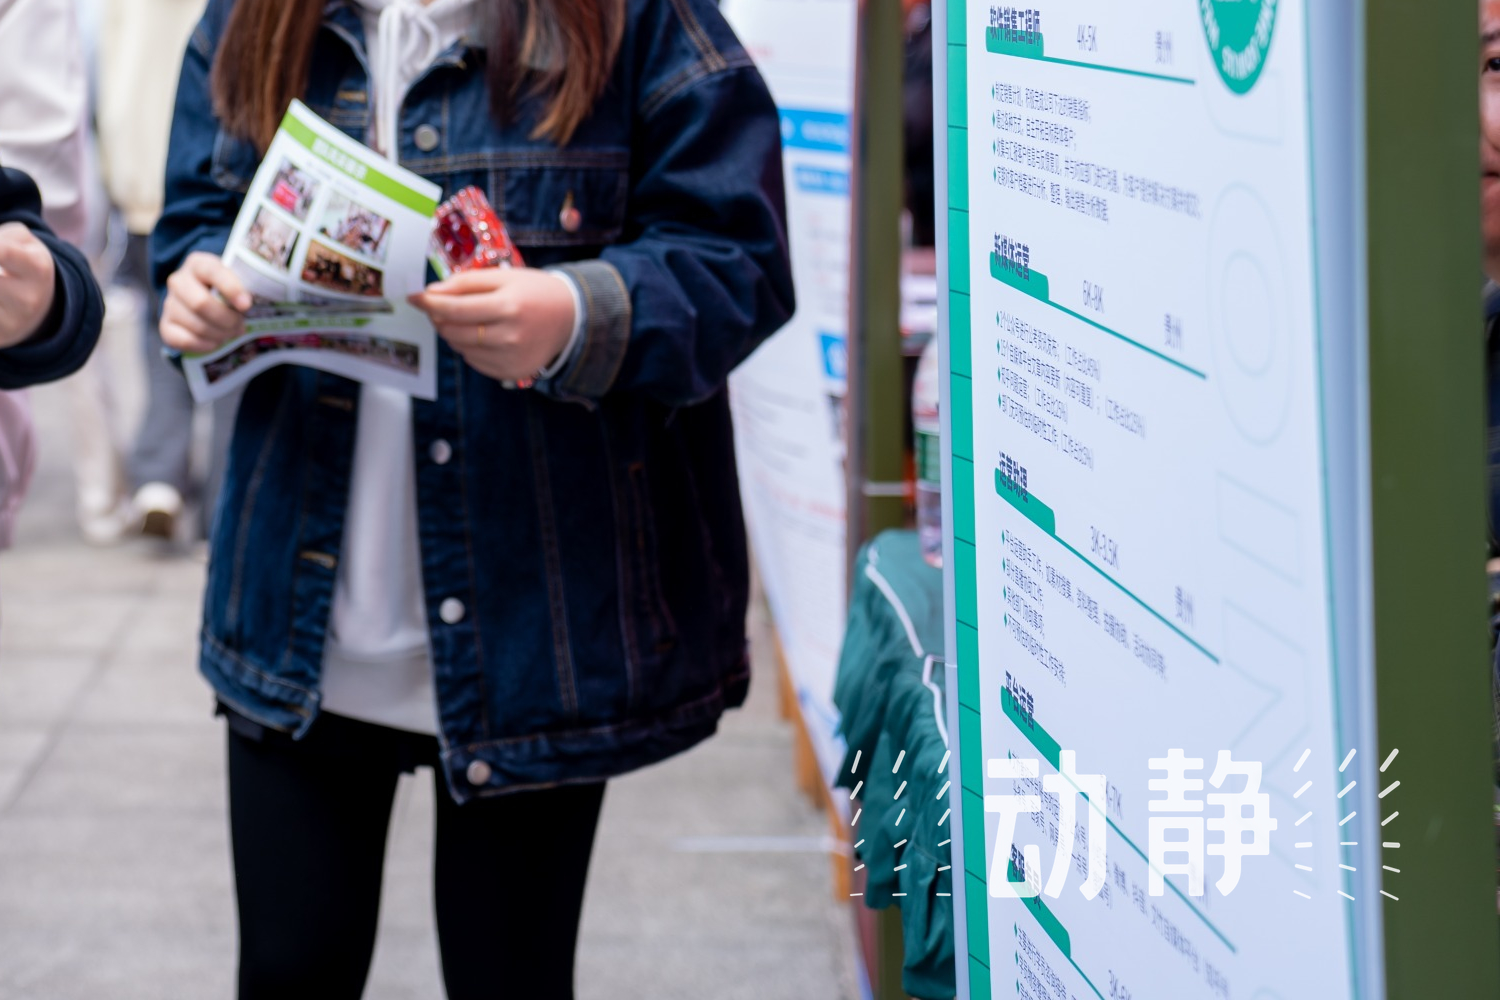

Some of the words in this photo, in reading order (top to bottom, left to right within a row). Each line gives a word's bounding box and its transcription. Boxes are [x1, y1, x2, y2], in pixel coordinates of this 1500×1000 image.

[994, 232, 1030, 282] 新媒体运营
[998, 452, 1028, 504] 运营助理
[1005, 671, 1035, 732] 平台运营
